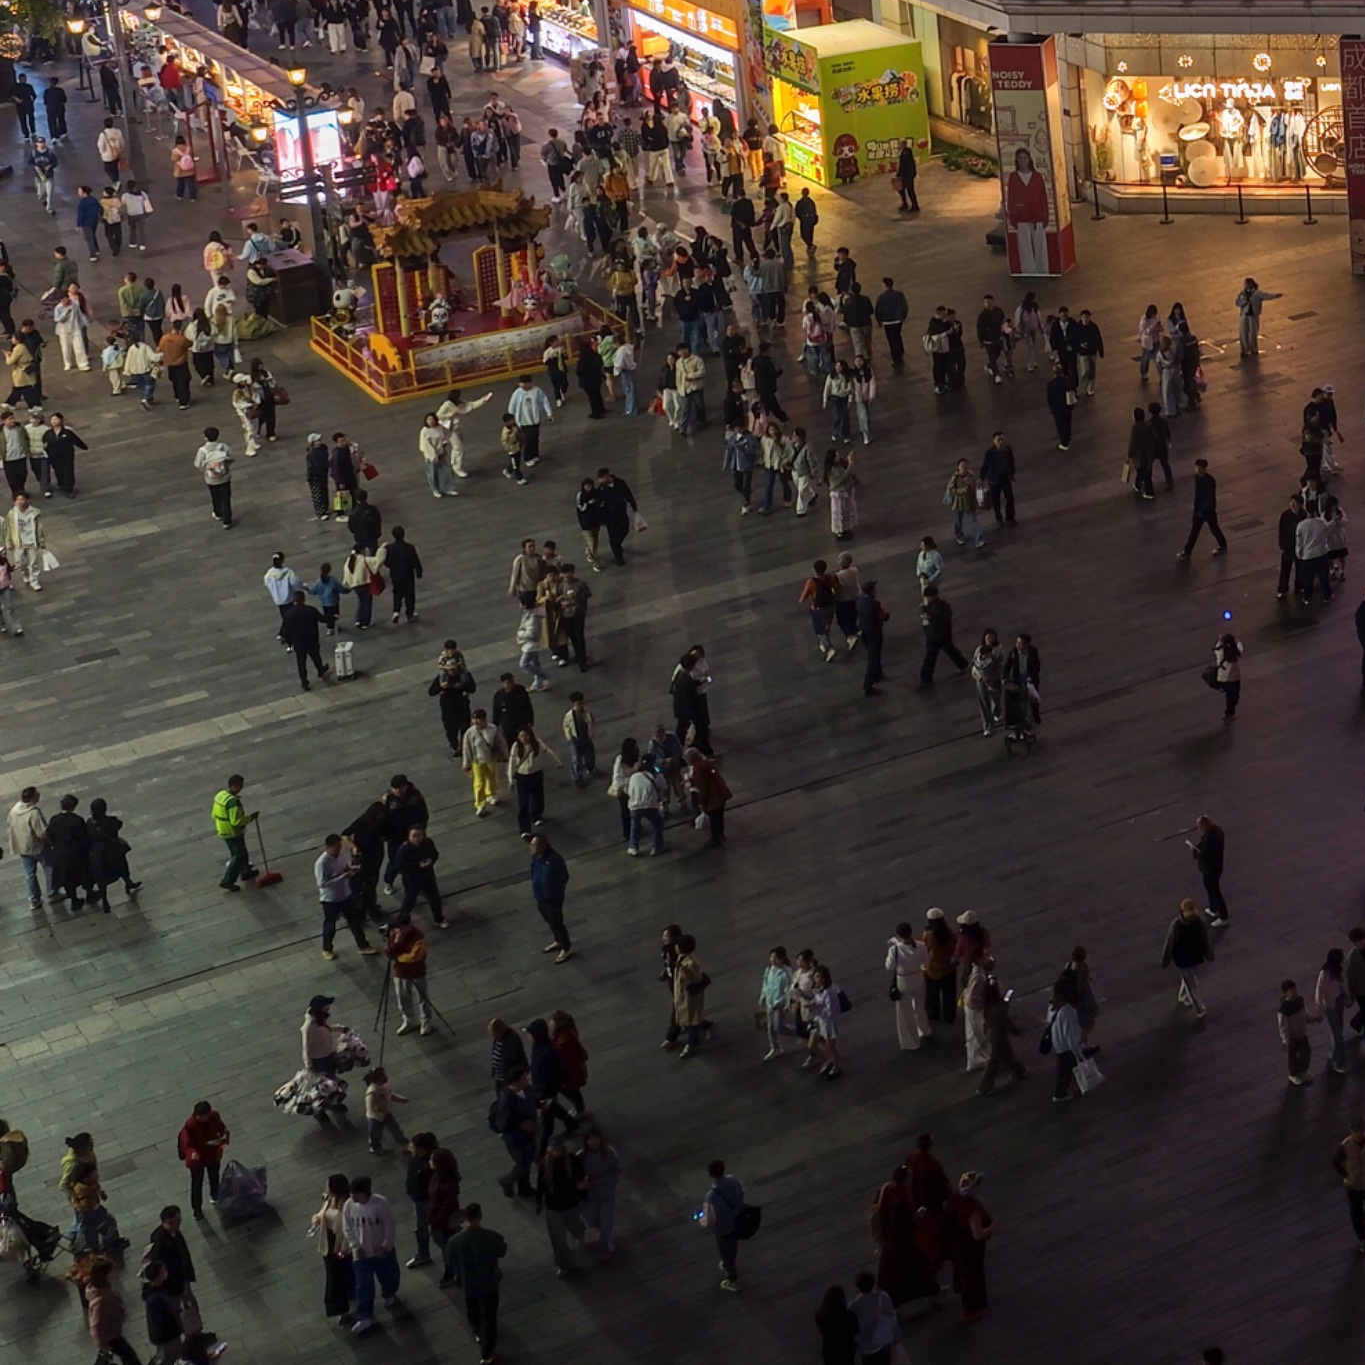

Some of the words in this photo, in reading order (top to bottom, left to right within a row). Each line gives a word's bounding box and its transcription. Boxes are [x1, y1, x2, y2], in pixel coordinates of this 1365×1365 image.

[992, 71, 1025, 80] NOISY
[998, 80, 1033, 90] TEDDY
[856, 83, 900, 103] 水果捞
